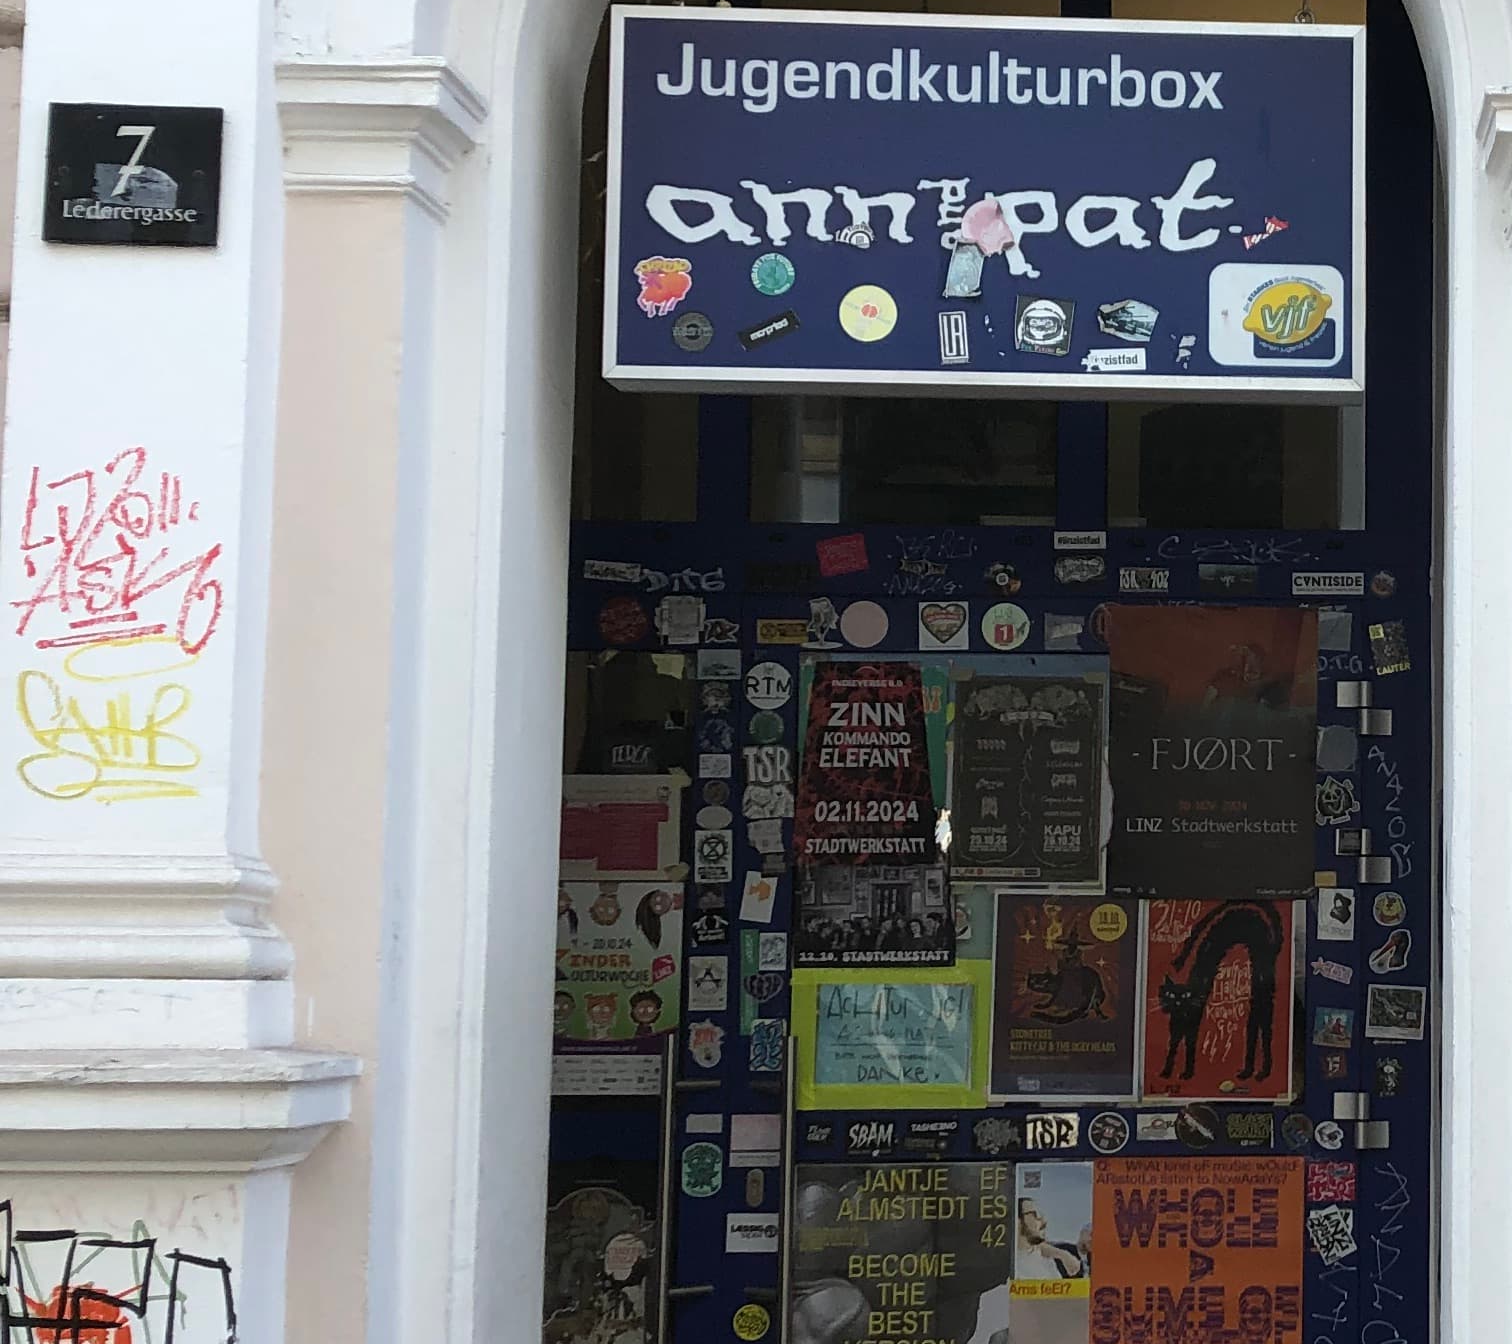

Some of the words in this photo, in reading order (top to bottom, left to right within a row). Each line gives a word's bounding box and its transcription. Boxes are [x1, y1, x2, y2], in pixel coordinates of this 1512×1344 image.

[656, 42, 1224, 112] Jugendkulturbox
[110, 125, 156, 197] 7
[63, 199, 198, 225] Lederergasse
[645, 179, 915, 247] ann
[1261, 295, 1317, 339] vjf
[745, 676, 792, 695] RTM
[827, 701, 907, 727] ZINN
[823, 731, 911, 746] KOMMANDO
[818, 747, 912, 768] ELEFANT
[813, 800, 920, 823] 02.11.2024
[1043, 824, 1081, 836] KAPU
[1126, 817, 1163, 833] LINZ
[1171, 817, 1299, 834] Stadtwerkstatt
[804, 837, 926, 855] STADTWERKSTATT
[842, 950, 950, 962] STADTWERKSTATT
[860, 1168, 949, 1193] JANTJE
[980, 1167, 1007, 1192] EF
[836, 1196, 970, 1222] ALMSTEDT
[979, 1195, 1007, 1219] ES
[980, 1224, 1006, 1248] 42
[848, 1253, 956, 1278] BECOME
[876, 1282, 927, 1306] THE
[868, 1310, 935, 1336] BEST
